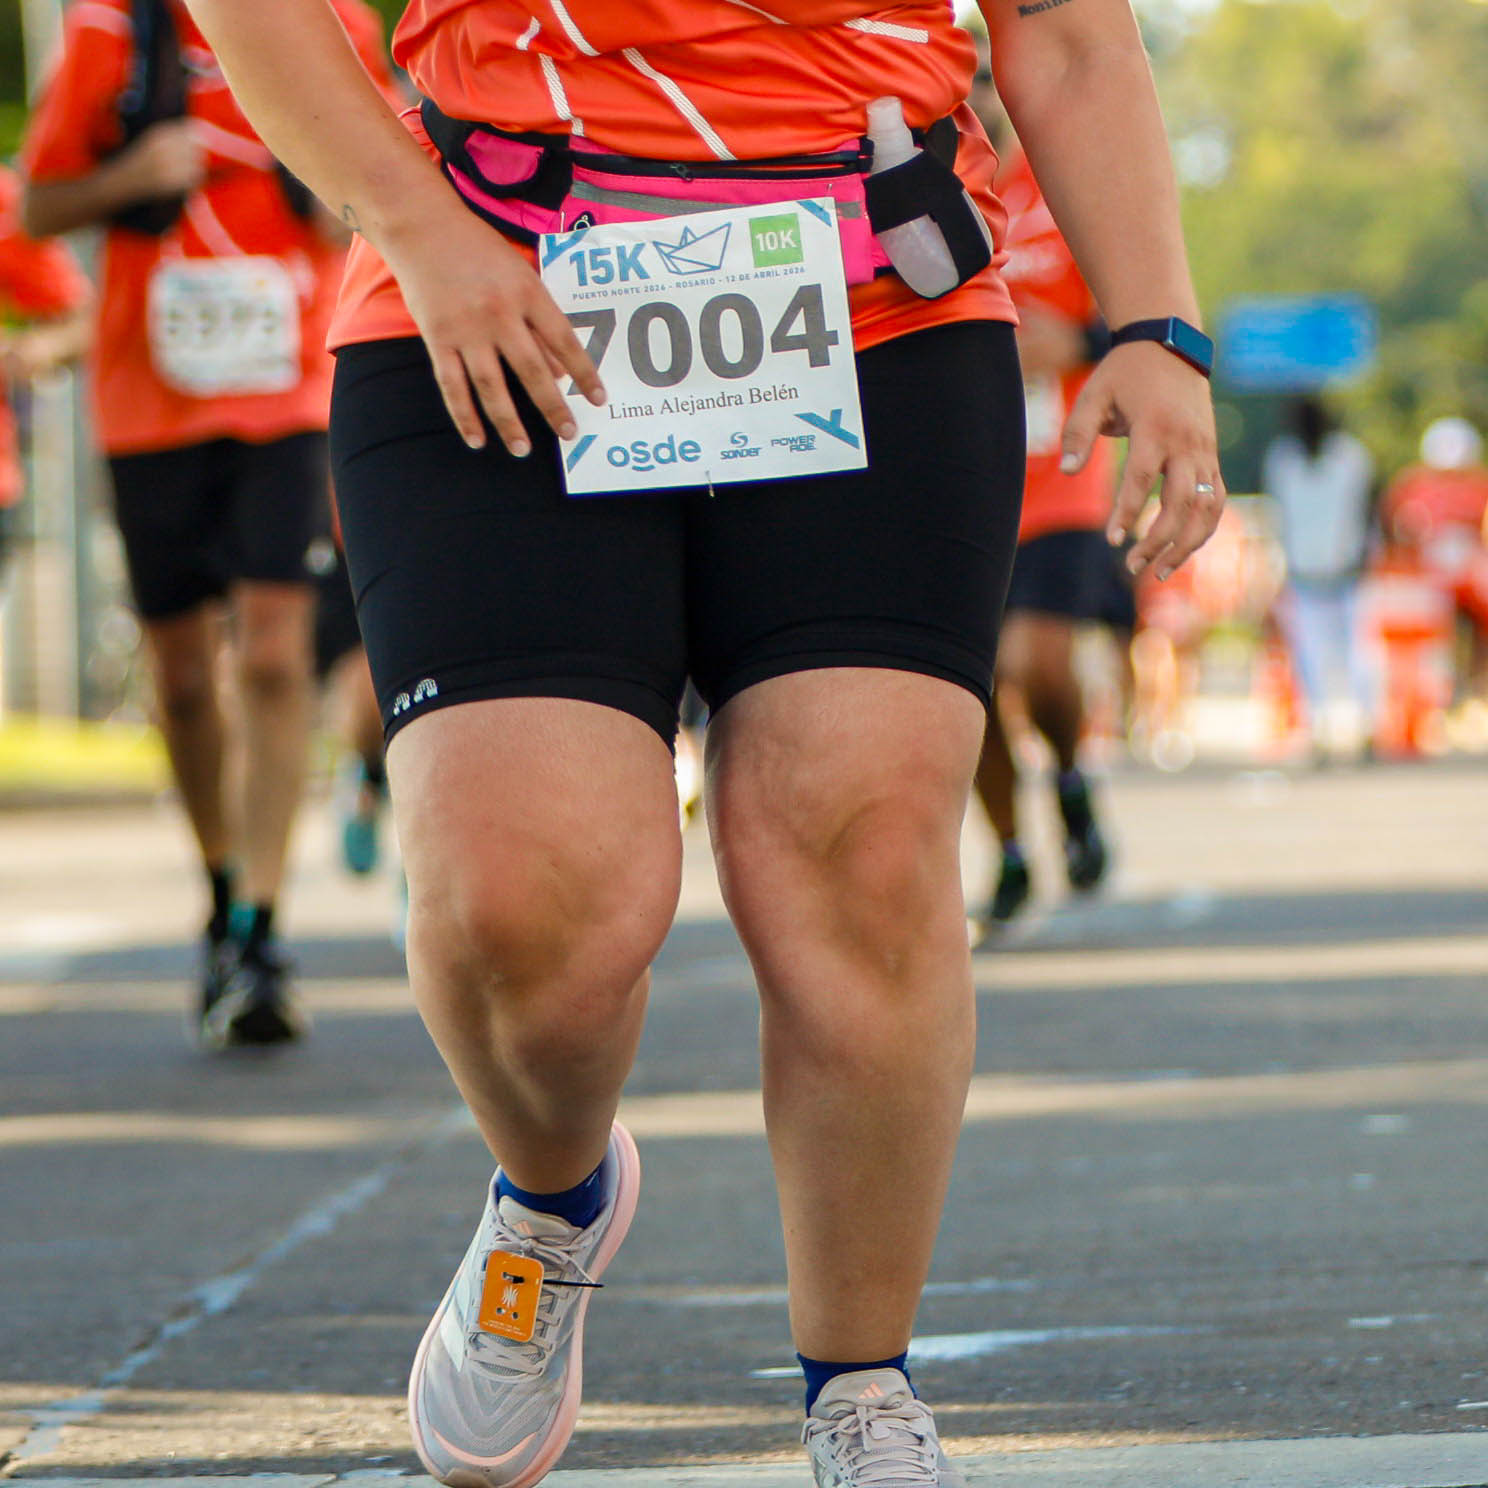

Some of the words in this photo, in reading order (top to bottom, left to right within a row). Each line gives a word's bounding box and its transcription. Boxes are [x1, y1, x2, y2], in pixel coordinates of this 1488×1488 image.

[755, 229, 795, 252] 10K
[569, 242, 650, 287] 15K
[572, 290, 609, 301] PUERTO
[612, 287, 641, 297] NORTE
[644, 284, 666, 293] 2026
[675, 278, 716, 289] ROSARIO
[725, 275, 735, 283] 12
[739, 273, 751, 281] DE
[754, 270, 781, 279] ABRIL
[783, 267, 806, 276] 2026
[565, 283, 839, 397] 7004
[608, 403, 654, 420] Lima
[661, 391, 743, 416] Alejandra
[749, 384, 800, 405] Belén
[607, 433, 702, 471] osde
[771, 434, 816, 447] POWER
